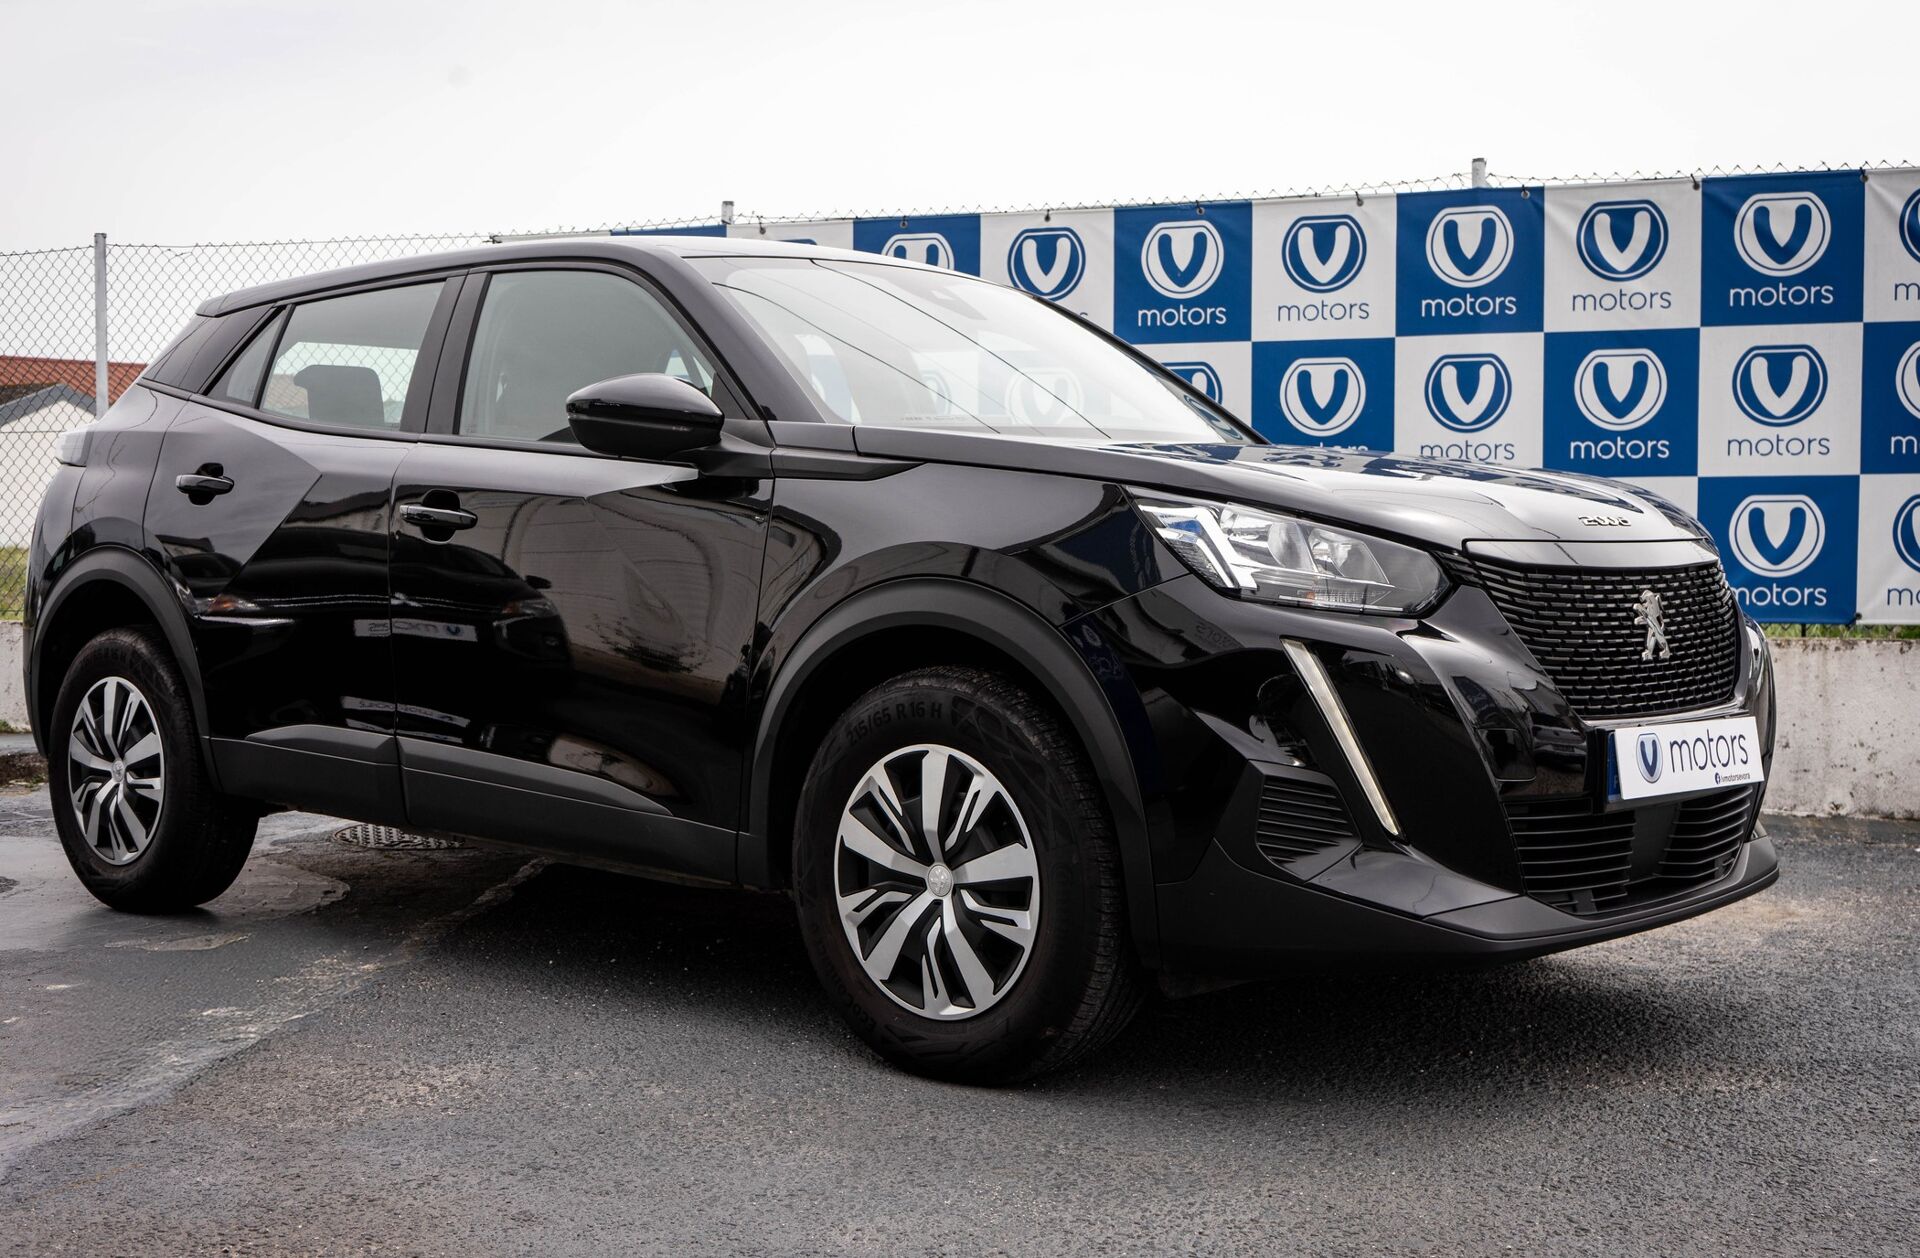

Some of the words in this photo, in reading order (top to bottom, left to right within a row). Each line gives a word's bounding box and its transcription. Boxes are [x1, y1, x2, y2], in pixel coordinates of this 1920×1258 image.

[1421, 294, 1517, 317] motors
[1572, 289, 1672, 311] motors
[1730, 283, 1833, 307] motors
[1138, 304, 1226, 326] motors
[1277, 300, 1370, 321] motors
[1420, 440, 1515, 461] motors
[1570, 436, 1670, 459] motors
[1727, 434, 1830, 456] motors
[896, 703, 907, 719] R
[910, 701, 925, 718] 16
[930, 702, 942, 719] H
[1669, 729, 1749, 773] motors
